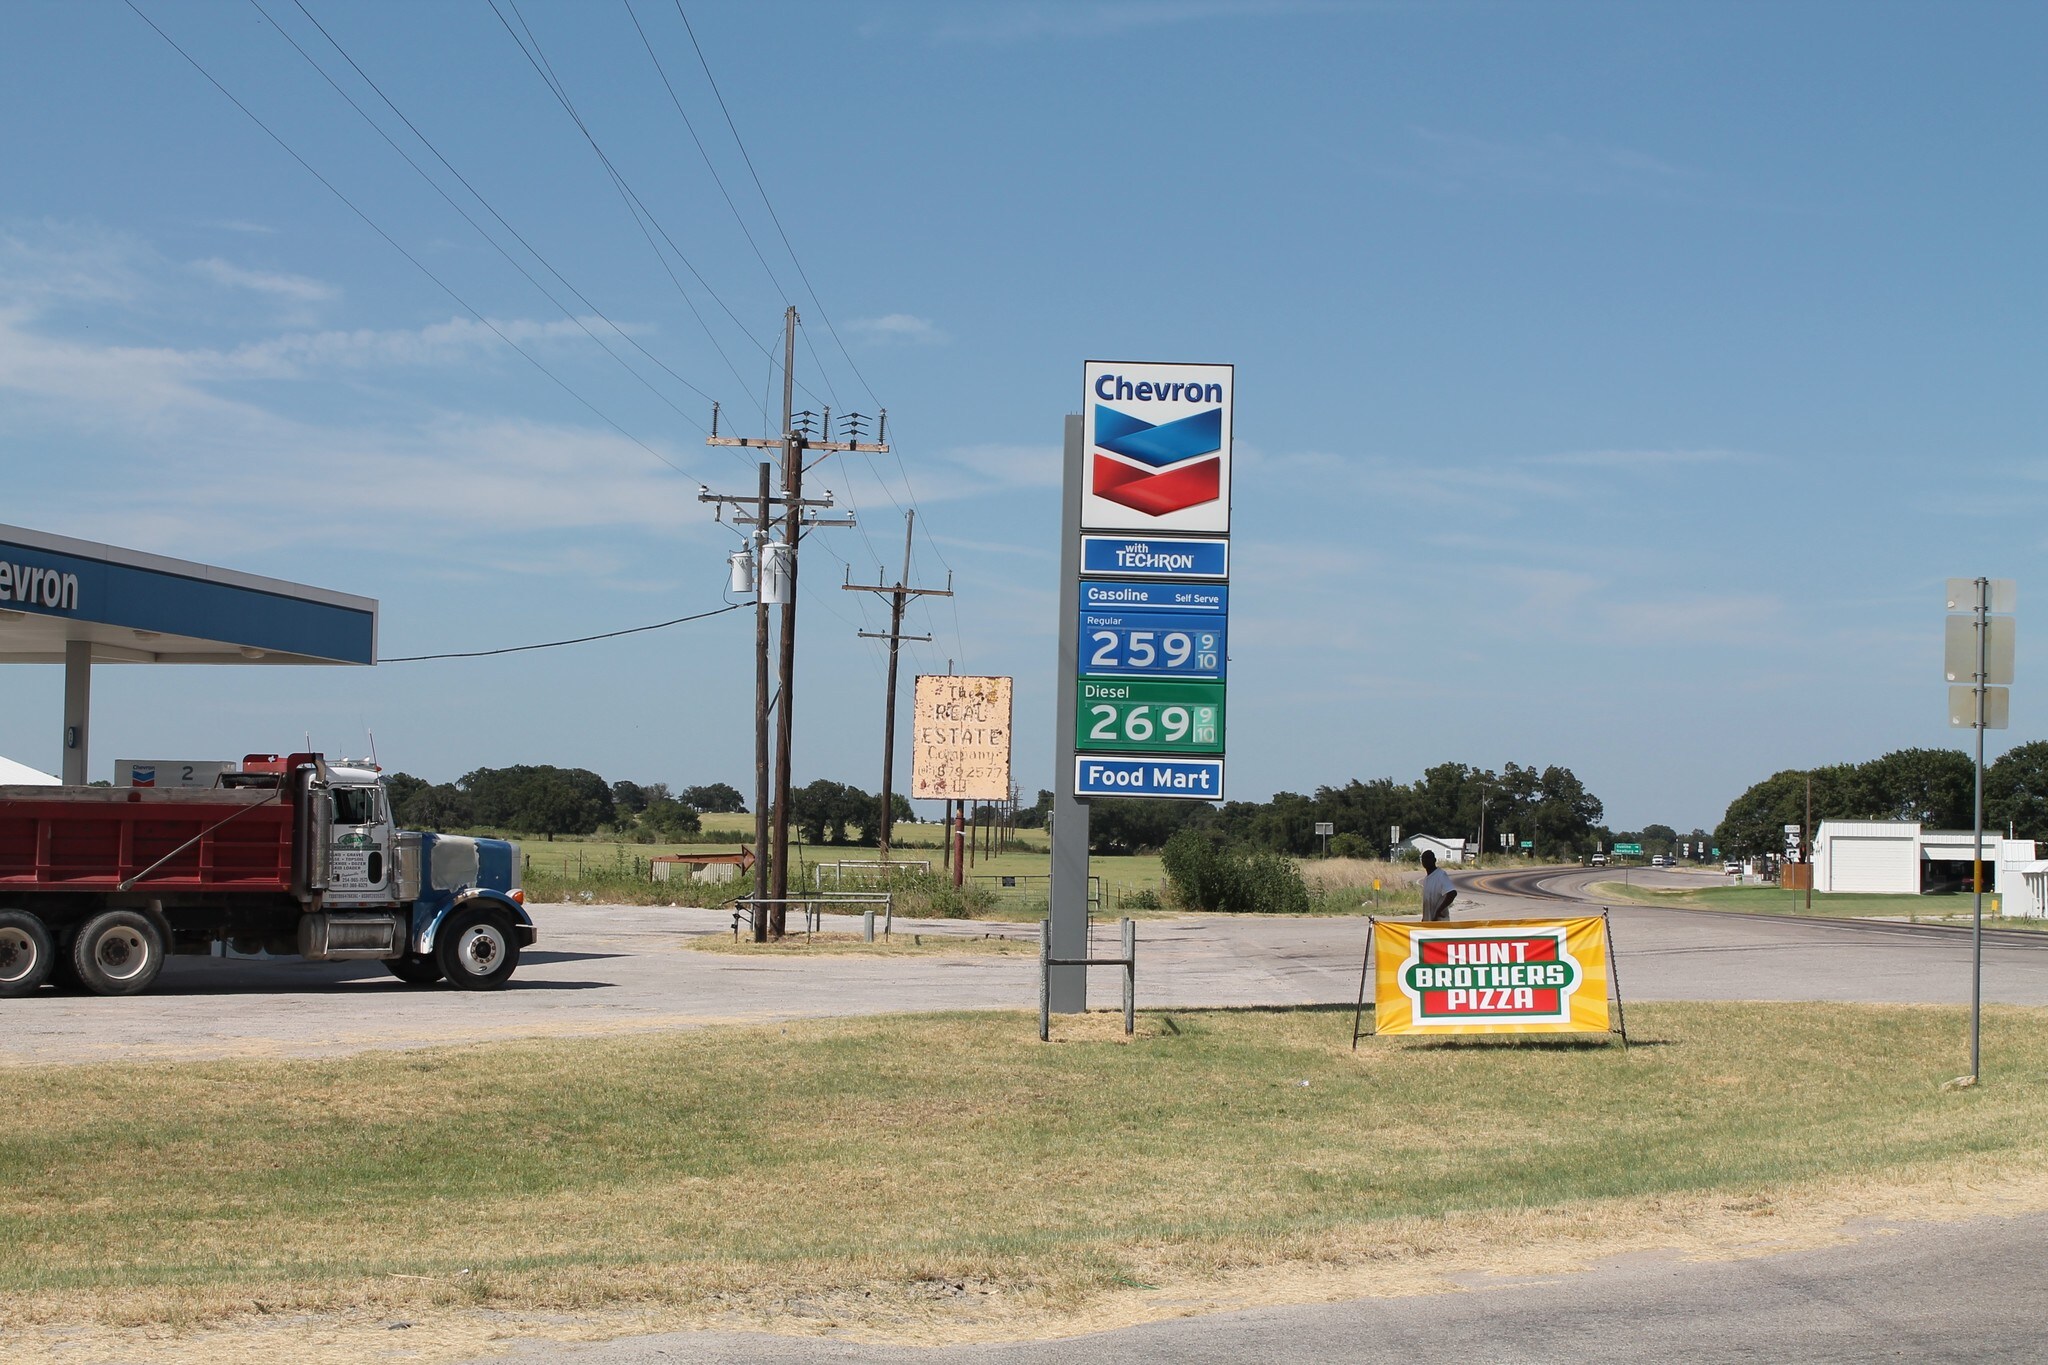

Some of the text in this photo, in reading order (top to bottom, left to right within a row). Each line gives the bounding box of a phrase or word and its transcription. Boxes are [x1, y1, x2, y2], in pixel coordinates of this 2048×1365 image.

[1095, 374, 1222, 403] Chevron
[1125, 543, 1149, 553] with
[1115, 550, 1192, 571] TECHRON
[1088, 588, 1148, 601] Gasoline
[1175, 593, 1219, 604] Self Serve
[1087, 616, 1122, 626] Regular
[1091, 631, 1191, 668] 259
[1201, 634, 1214, 649] 9
[1198, 653, 1217, 669] 10
[1085, 685, 1129, 698] Diesel
[936, 703, 987, 722] REAL
[1200, 707, 1212, 723] 9
[1090, 704, 1190, 742] 269
[922, 728, 1000, 745] ESTATE
[1197, 727, 1215, 742] 10
[182, 766, 194, 780] 2
[1089, 765, 1209, 789] Food Mart
[1447, 942, 1529, 965] HUNT
[1415, 965, 1564, 987] BROTHERS
[1447, 988, 1533, 1010] PIZZA
